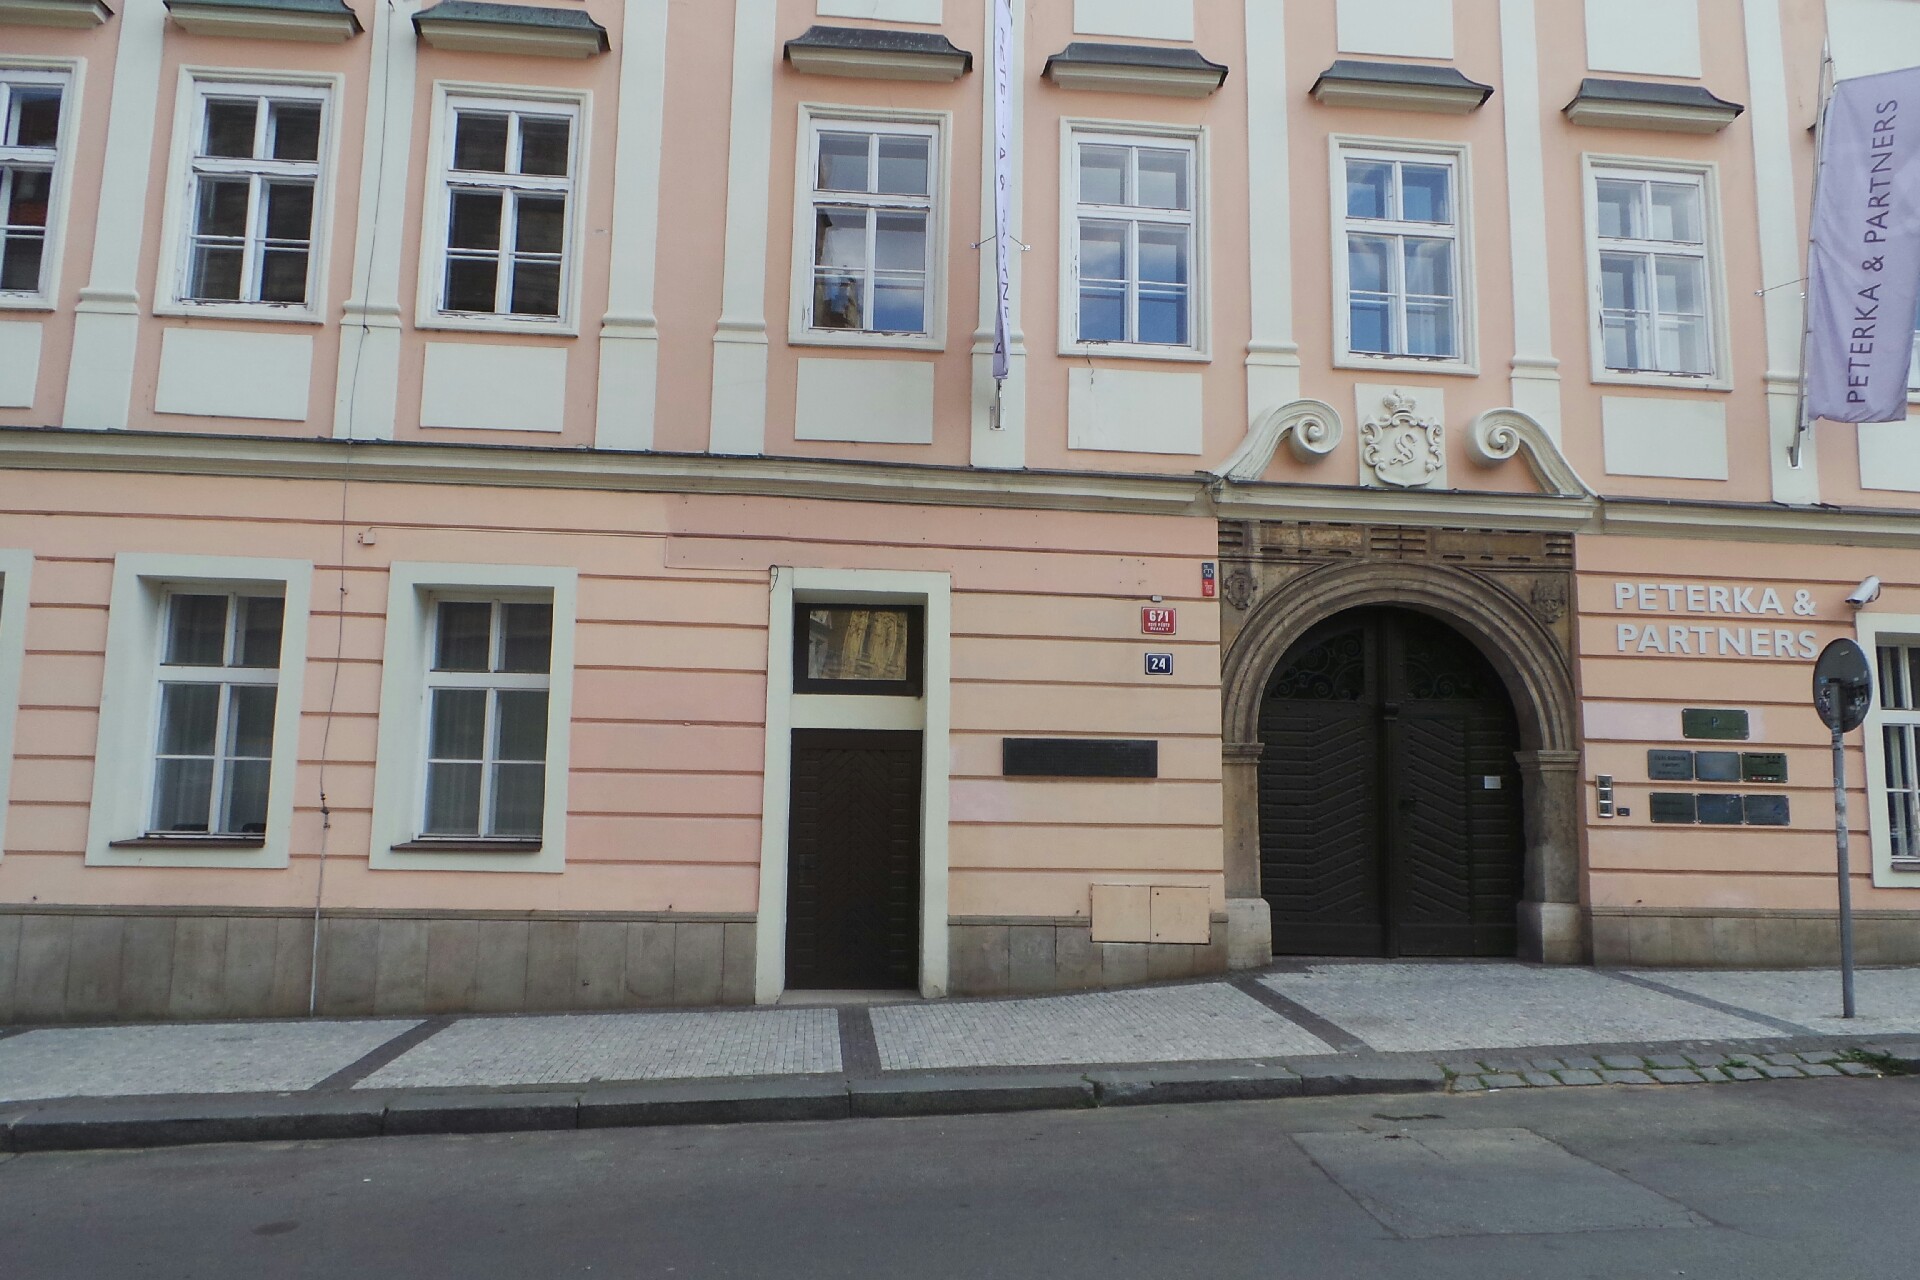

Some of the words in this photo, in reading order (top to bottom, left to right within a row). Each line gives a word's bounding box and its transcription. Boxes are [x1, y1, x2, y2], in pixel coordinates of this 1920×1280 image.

[1863, 99, 1898, 243] PARTNERS
[1861, 255, 1885, 272] &
[1846, 282, 1882, 403] PETERKA
[1149, 610, 1169, 622] 671
[1614, 582, 1785, 614] PETERKA
[1793, 588, 1816, 616] &
[1616, 623, 1819, 659] PARTNERS
[1151, 657, 1166, 670] 24
